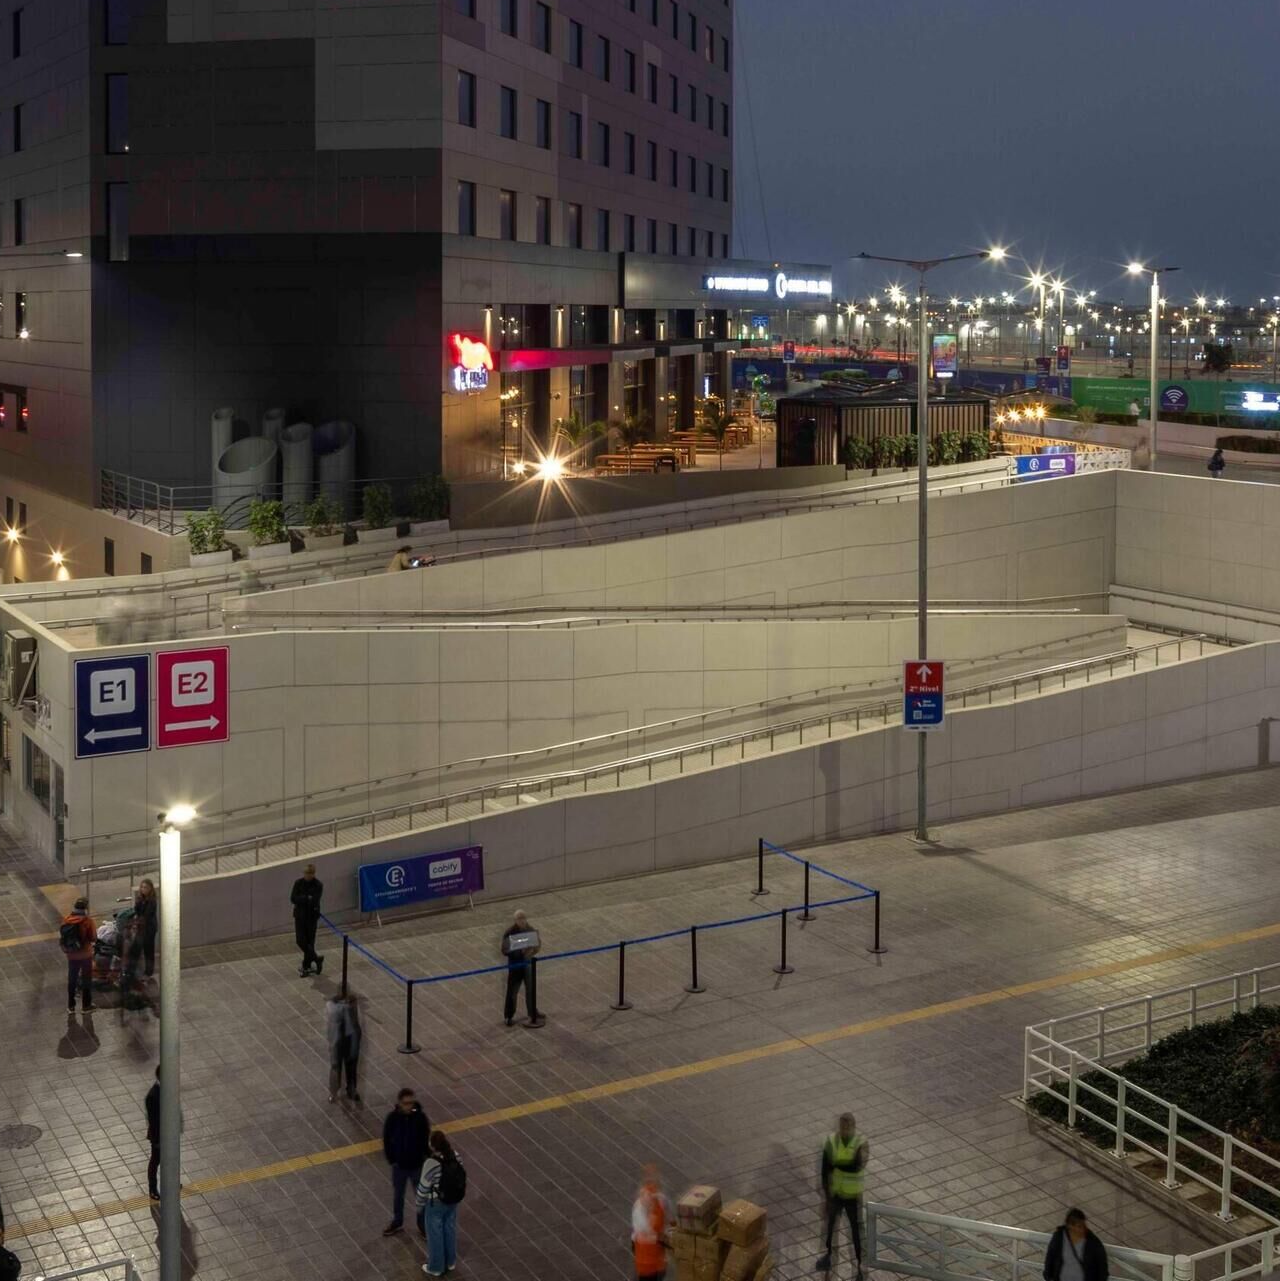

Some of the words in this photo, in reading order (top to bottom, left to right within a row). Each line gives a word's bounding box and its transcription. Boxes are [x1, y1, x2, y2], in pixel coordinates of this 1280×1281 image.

[99, 679, 127, 703] E1
[178, 672, 208, 695] E2
[432, 862, 458, 874] cabify
